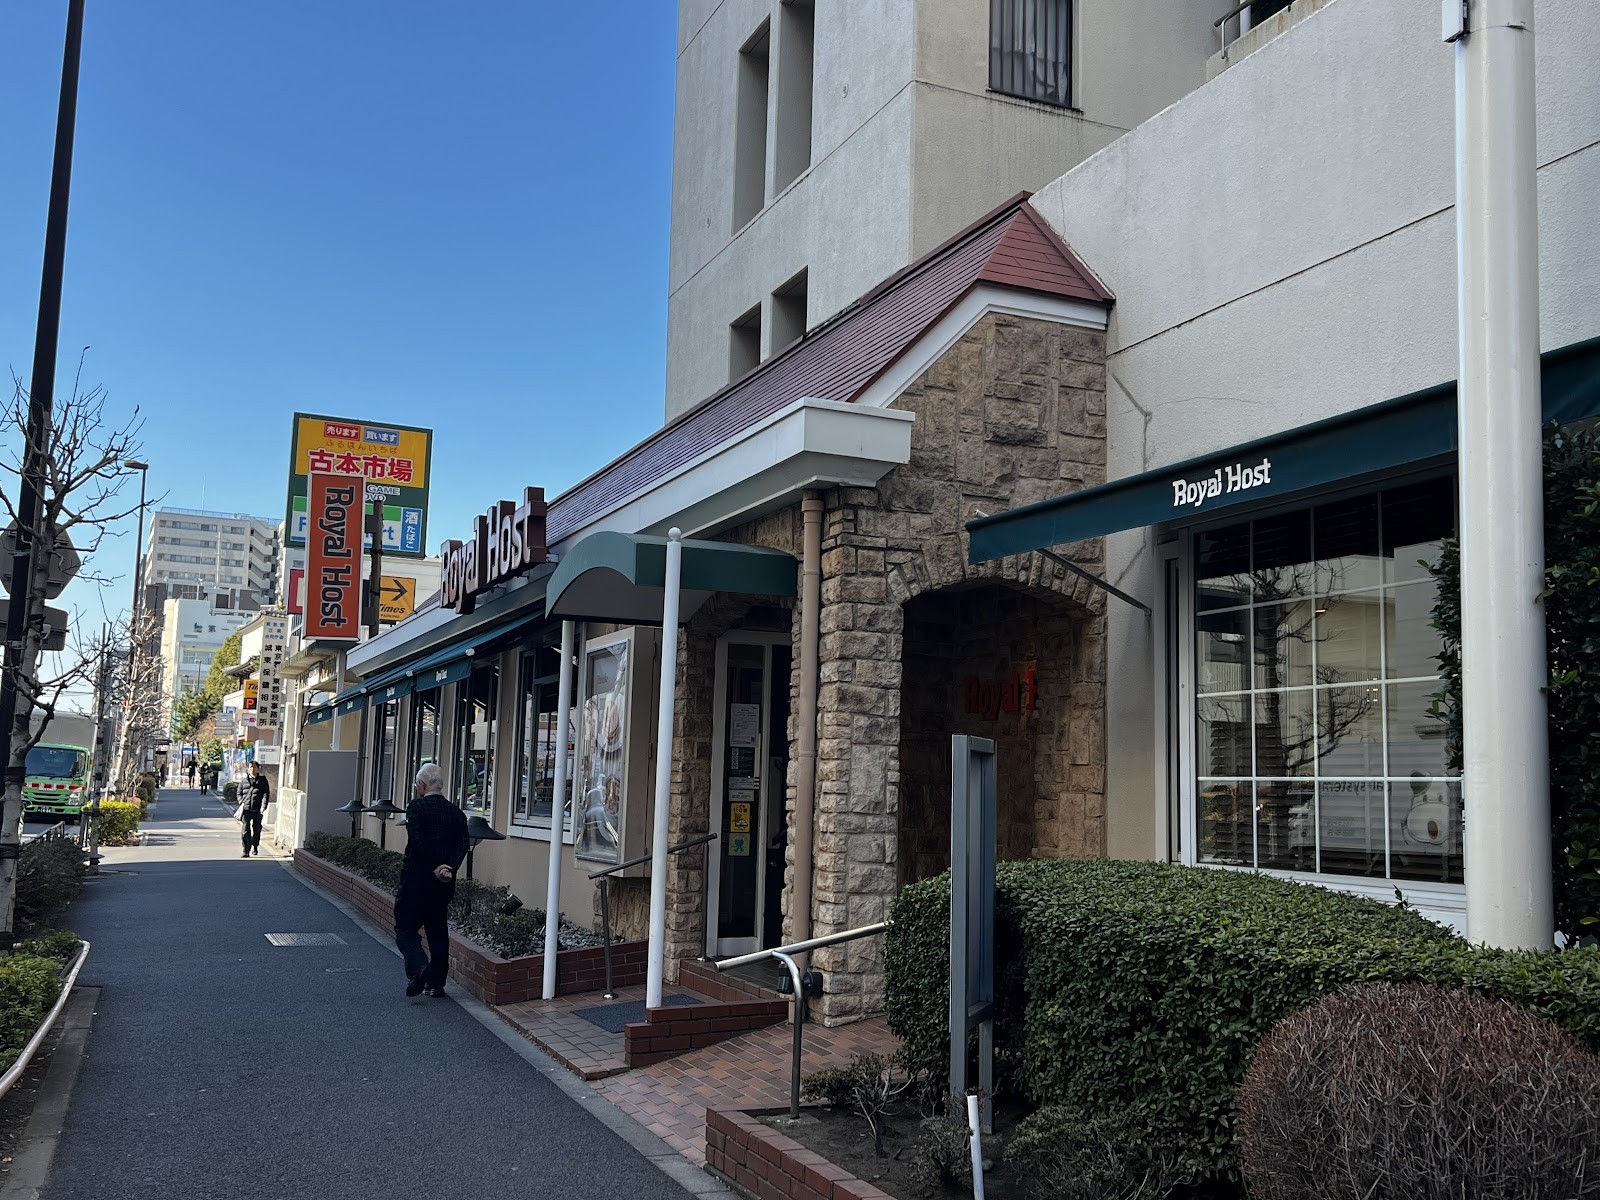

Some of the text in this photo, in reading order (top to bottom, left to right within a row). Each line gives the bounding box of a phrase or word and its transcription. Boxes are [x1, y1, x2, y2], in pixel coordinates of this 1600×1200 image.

[326, 425, 358, 438] 売ります
[366, 430, 397, 442] 買います
[326, 439, 398, 454] ふるほんいちば
[308, 449, 414, 483] 古本市場
[367, 484, 401, 495] GAME
[1172, 458, 1272, 507] Royal Host
[318, 486, 355, 627] Royal Host
[440, 486, 533, 614] Royal Host
[246, 698, 255, 710] P
[964, 671, 1020, 721] Royal
